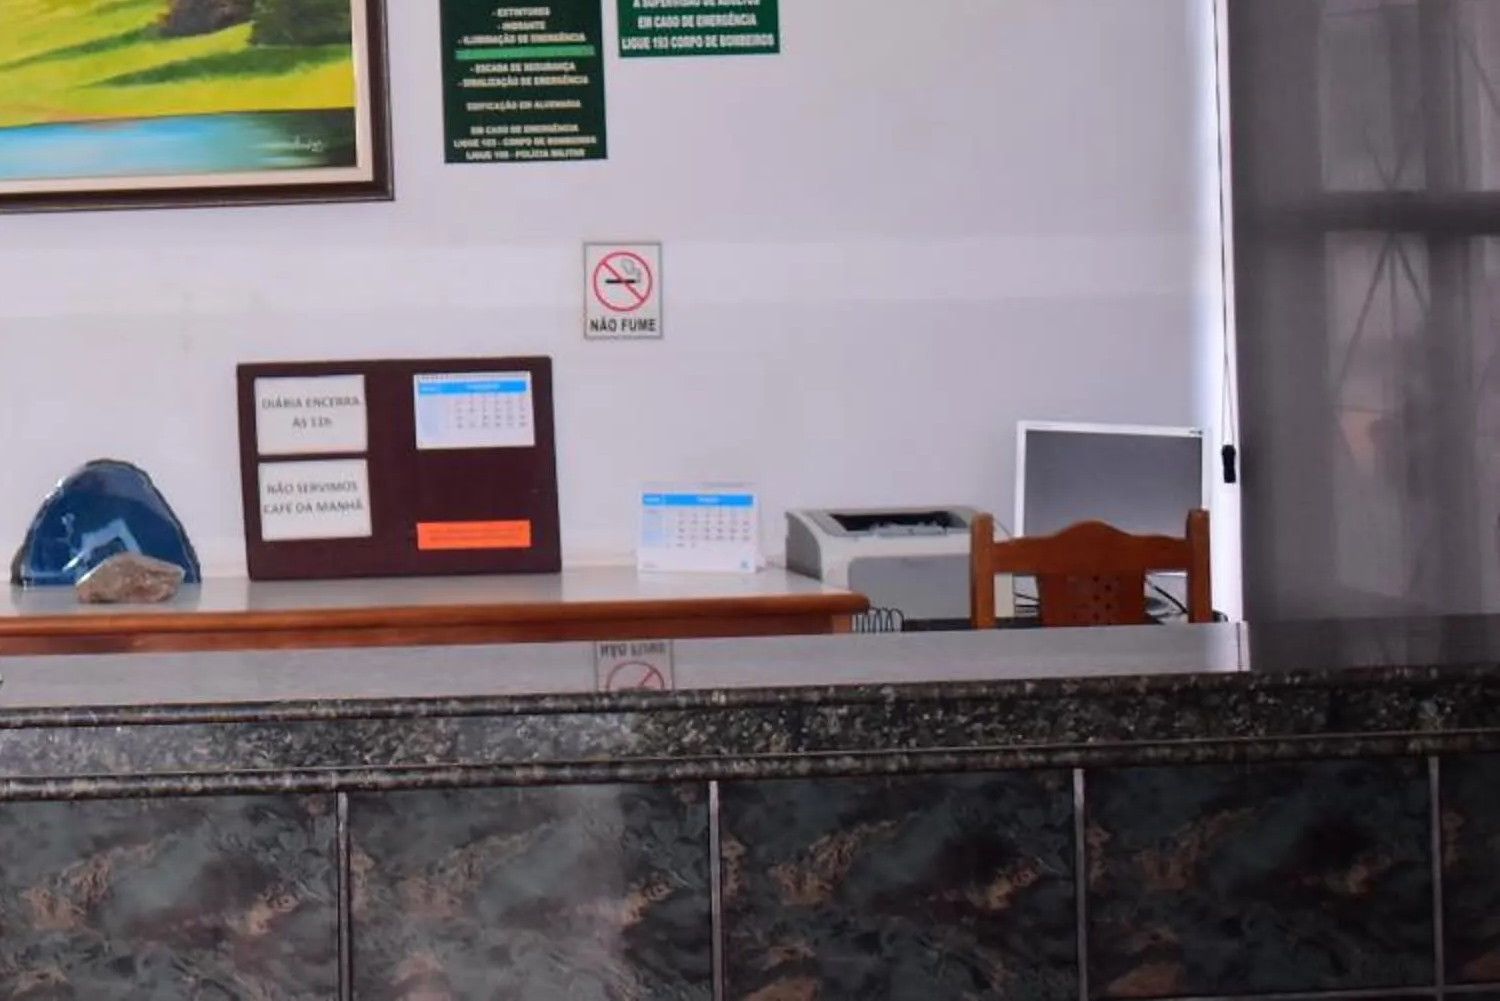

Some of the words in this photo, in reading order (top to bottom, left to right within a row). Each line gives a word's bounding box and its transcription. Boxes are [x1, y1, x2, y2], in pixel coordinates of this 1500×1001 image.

[637, 15, 652, 29] EM
[653, 15, 680, 28] CASO
[681, 14, 695, 28] DE
[696, 11, 757, 27] EMERGÊNCIA
[621, 36, 650, 49] LIGUE
[670, 35, 703, 48] CORPO
[704, 34, 718, 47] DE
[719, 33, 775, 47] BOMBEIROS
[510, 62, 522, 73] DE
[520, 75, 532, 86] DE
[485, 125, 509, 135] CASO
[510, 125, 522, 134] DE
[453, 138, 479, 148] LIGUE
[503, 137, 533, 147] CORPO
[534, 136, 546, 146] DE
[590, 316, 617, 332] NÃO
[621, 318, 656, 332] FUME
[295, 501, 312, 514] DA
